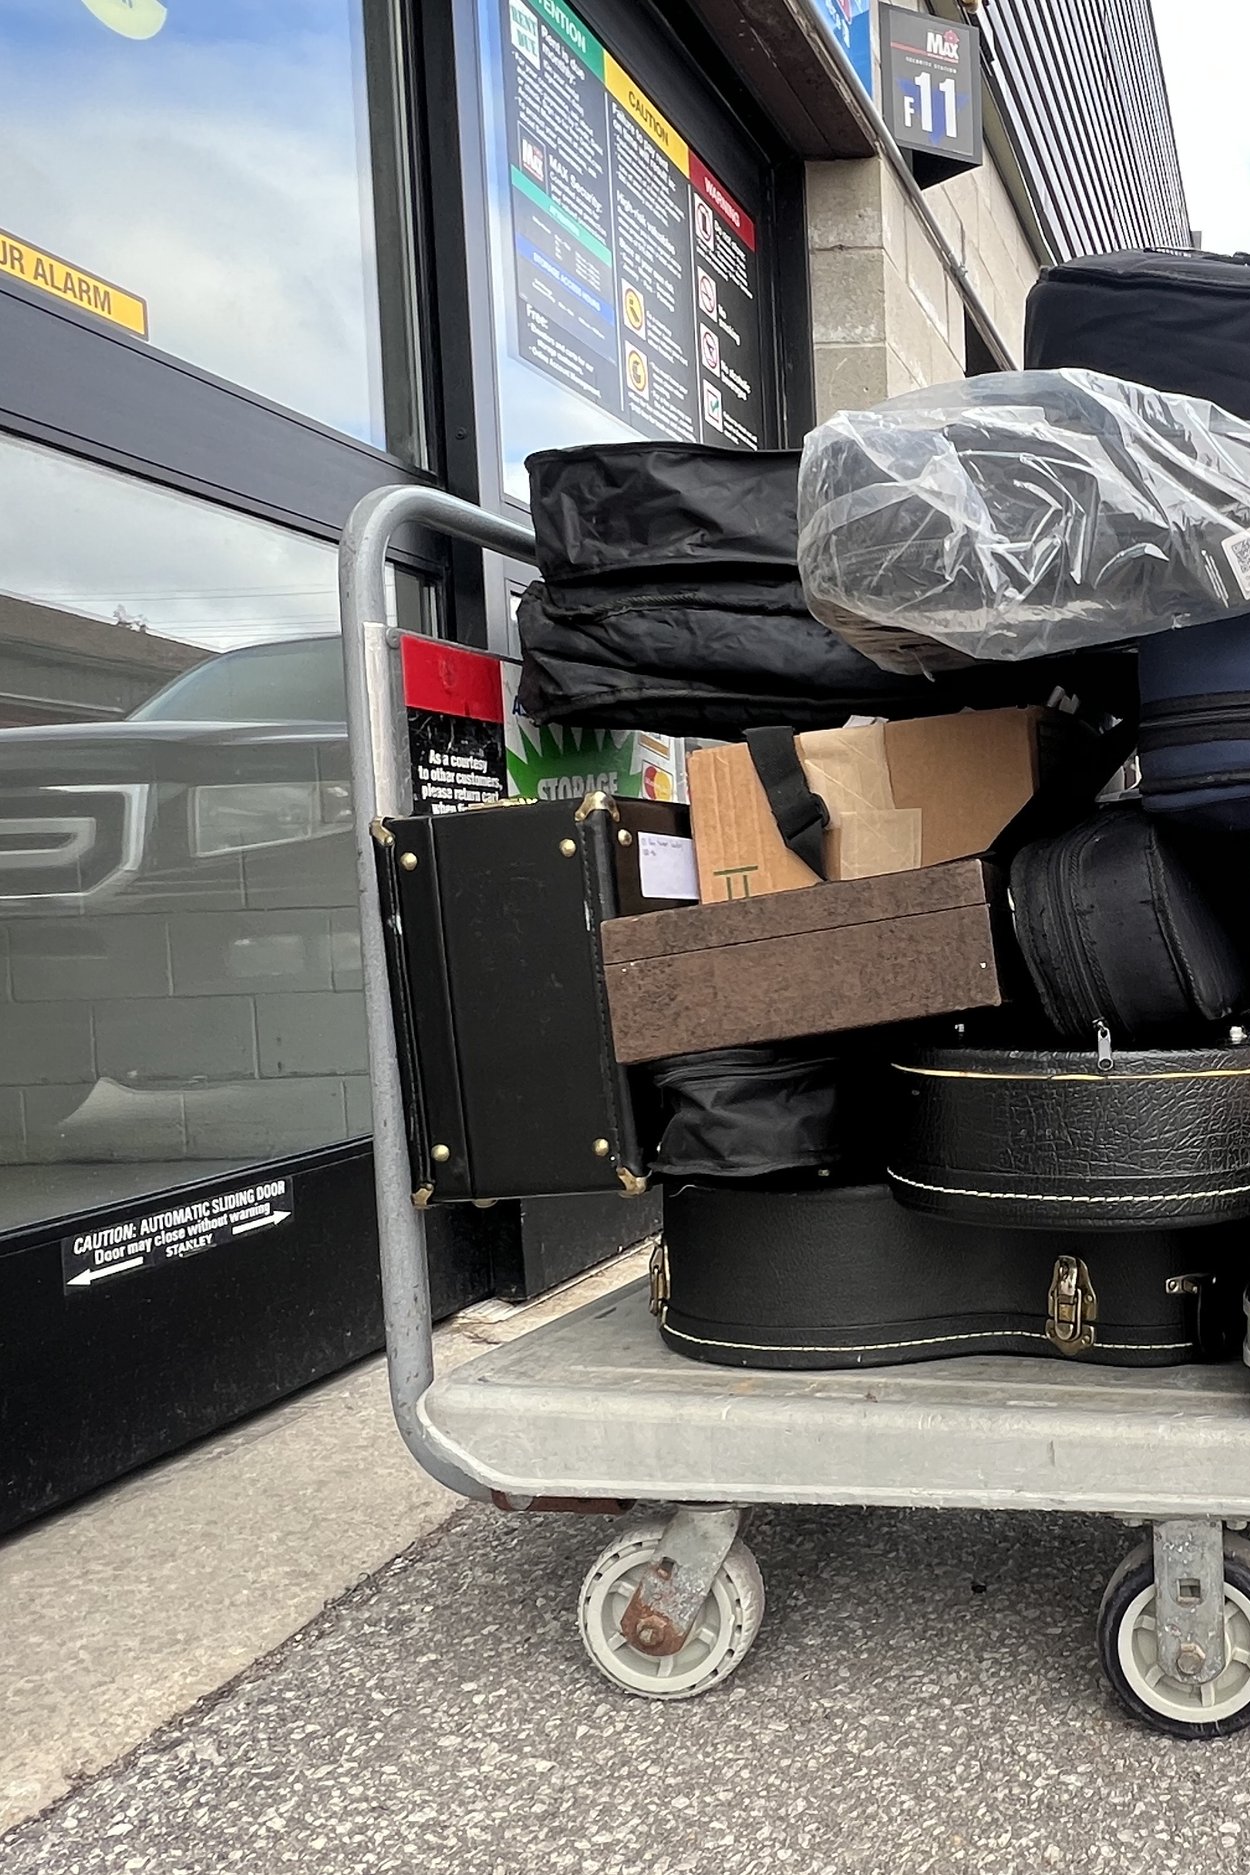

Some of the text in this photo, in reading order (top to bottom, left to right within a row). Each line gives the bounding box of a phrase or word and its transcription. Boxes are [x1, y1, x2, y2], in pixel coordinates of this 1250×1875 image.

[540, 0, 586, 53] ENTION
[927, 31, 959, 59] MAX
[628, 91, 669, 146] CAUTION
[548, 154, 568, 182] MAX
[704, 177, 741, 228] WARNING
[33, 257, 111, 316] ALARM
[429, 749, 488, 774] As a courtesy
[418, 765, 503, 791] to other customers,
[538, 772, 618, 800] STORAGE
[421, 783, 499, 803] please return cart
[431, 801, 457, 815] when
[74, 1180, 285, 1254] CAUTION: AUTOMATIC SLIDING DOOR
[94, 1202, 271, 1265] Door may close without warning
[165, 1233, 213, 1257] STANLEY
